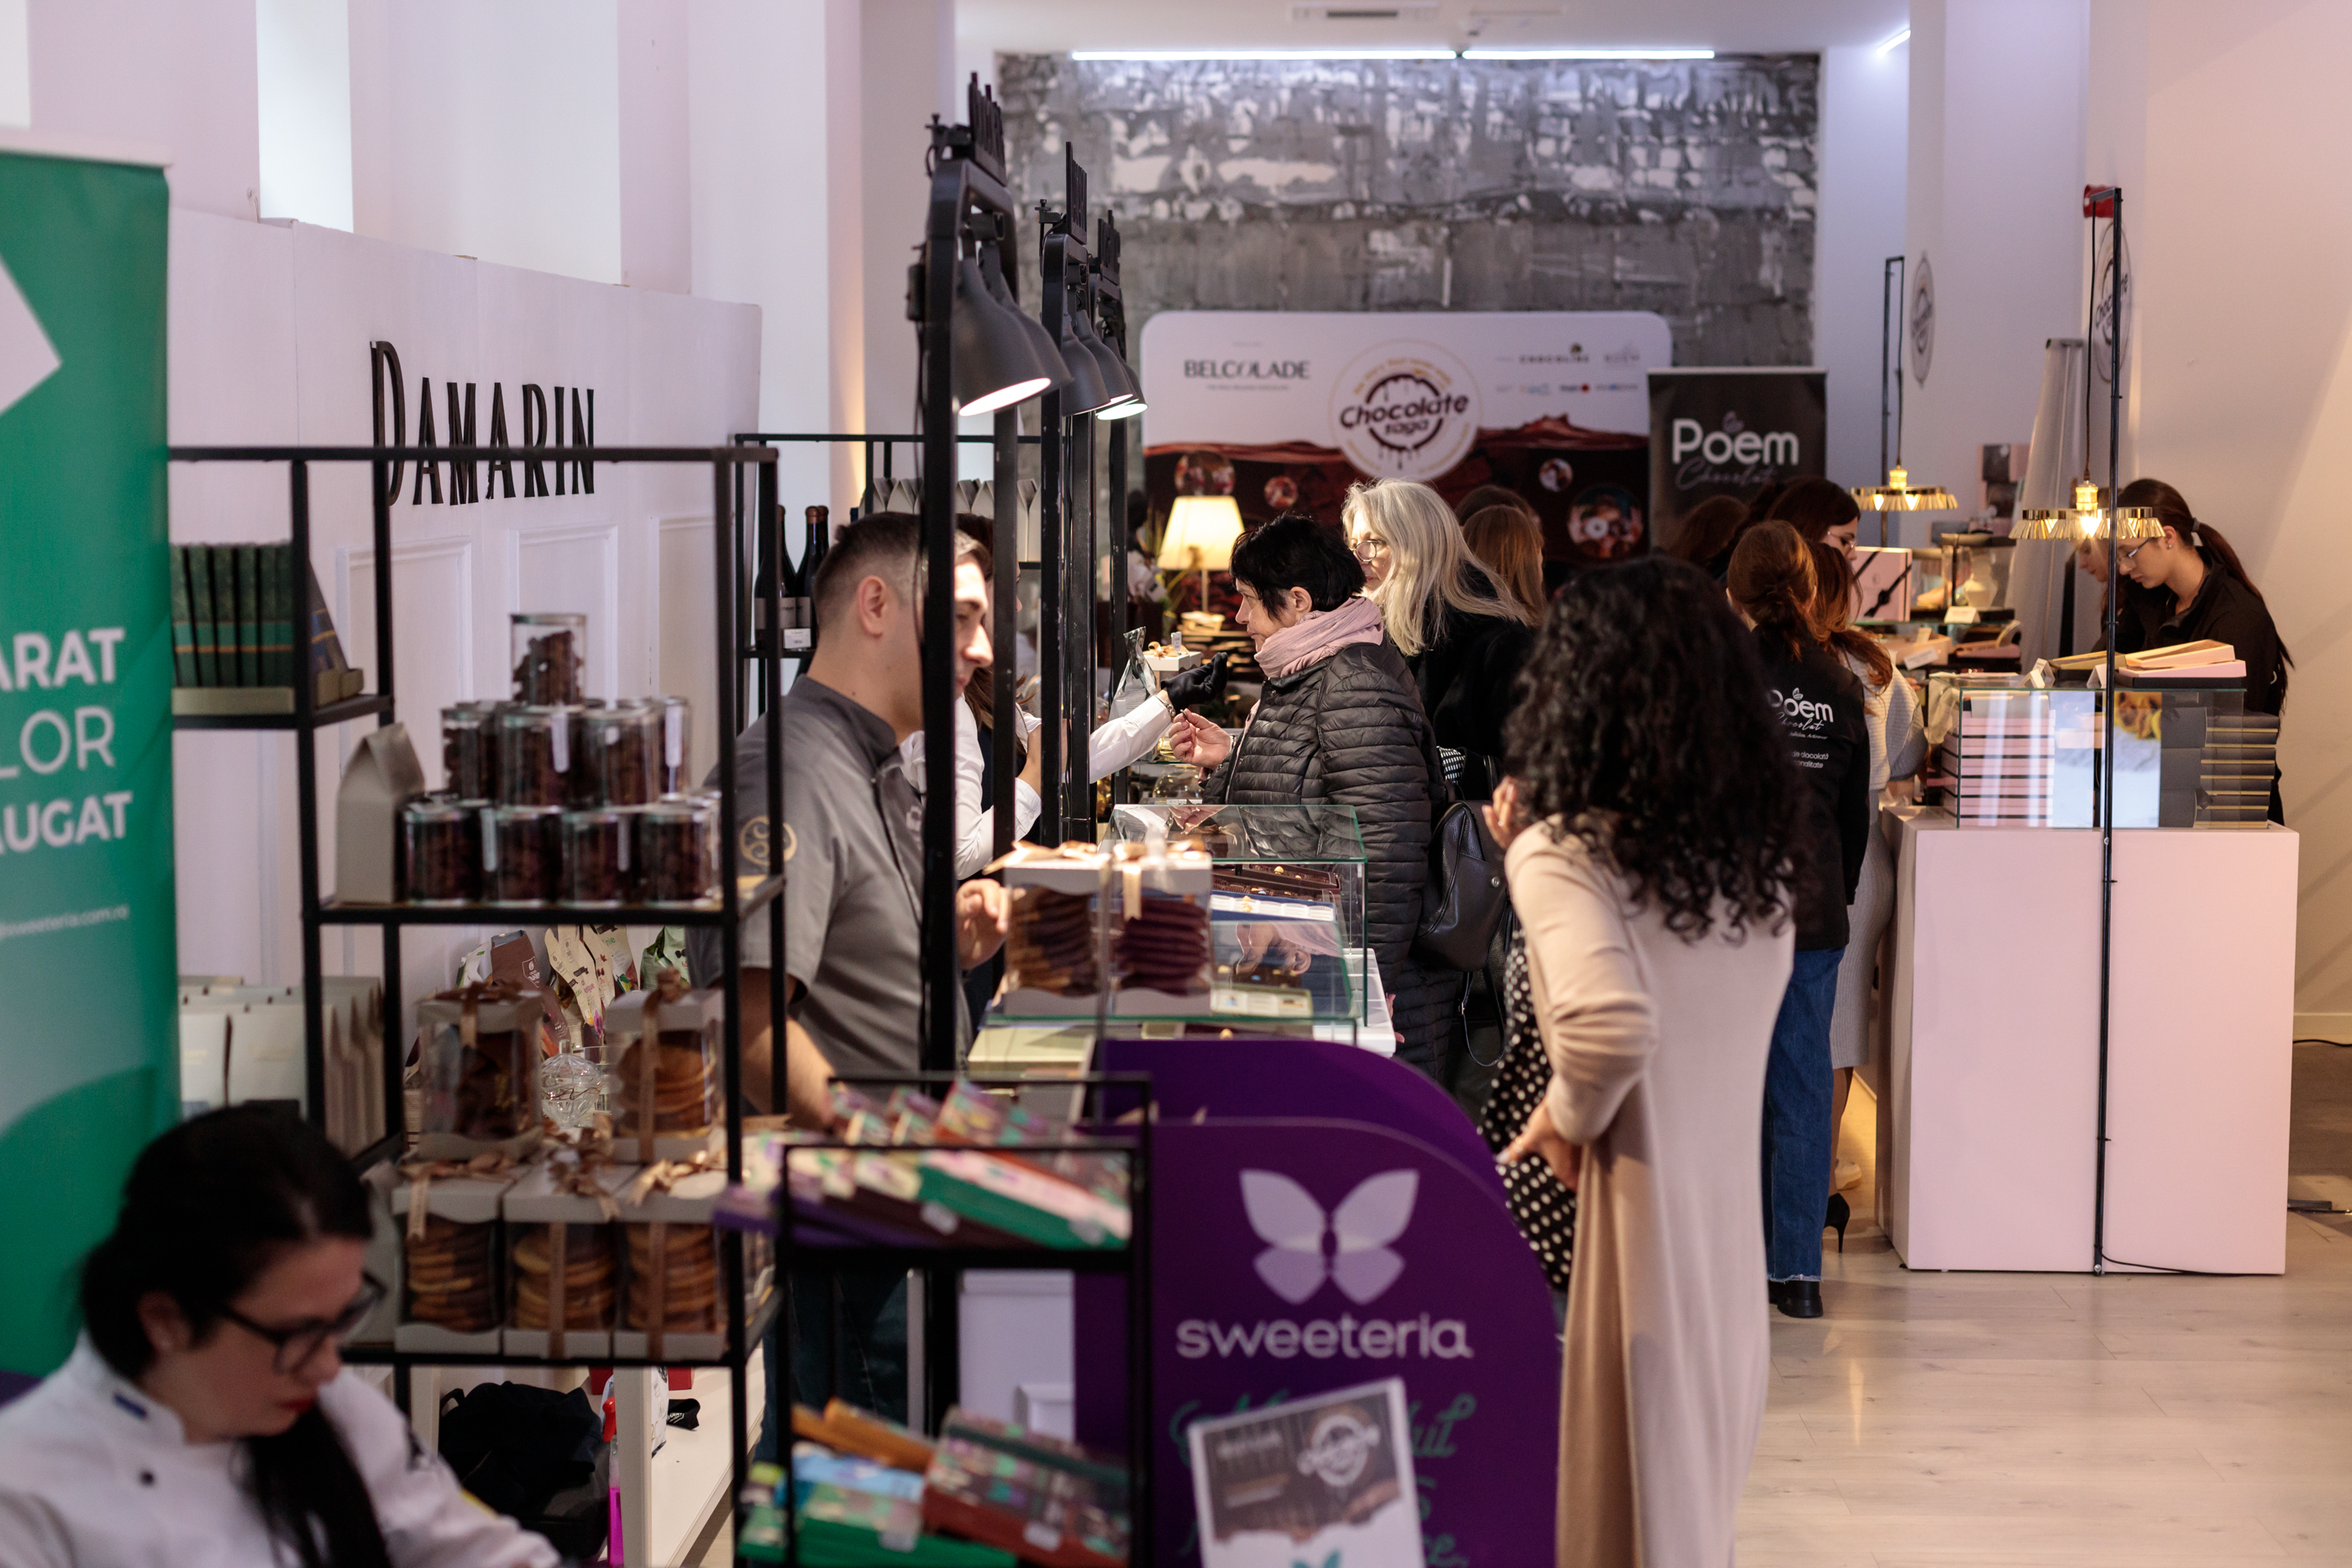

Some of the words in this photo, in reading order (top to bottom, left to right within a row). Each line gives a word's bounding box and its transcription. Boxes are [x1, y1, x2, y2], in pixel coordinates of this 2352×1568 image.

[1184, 359, 1311, 380] BELCOLADE
[370, 340, 595, 506] DAMARIN
[1340, 395, 1469, 431] Chocolate
[1672, 418, 1799, 465] Poem
[0, 791, 133, 854] UGAT
[1175, 1312, 1475, 1359] sweeteria
